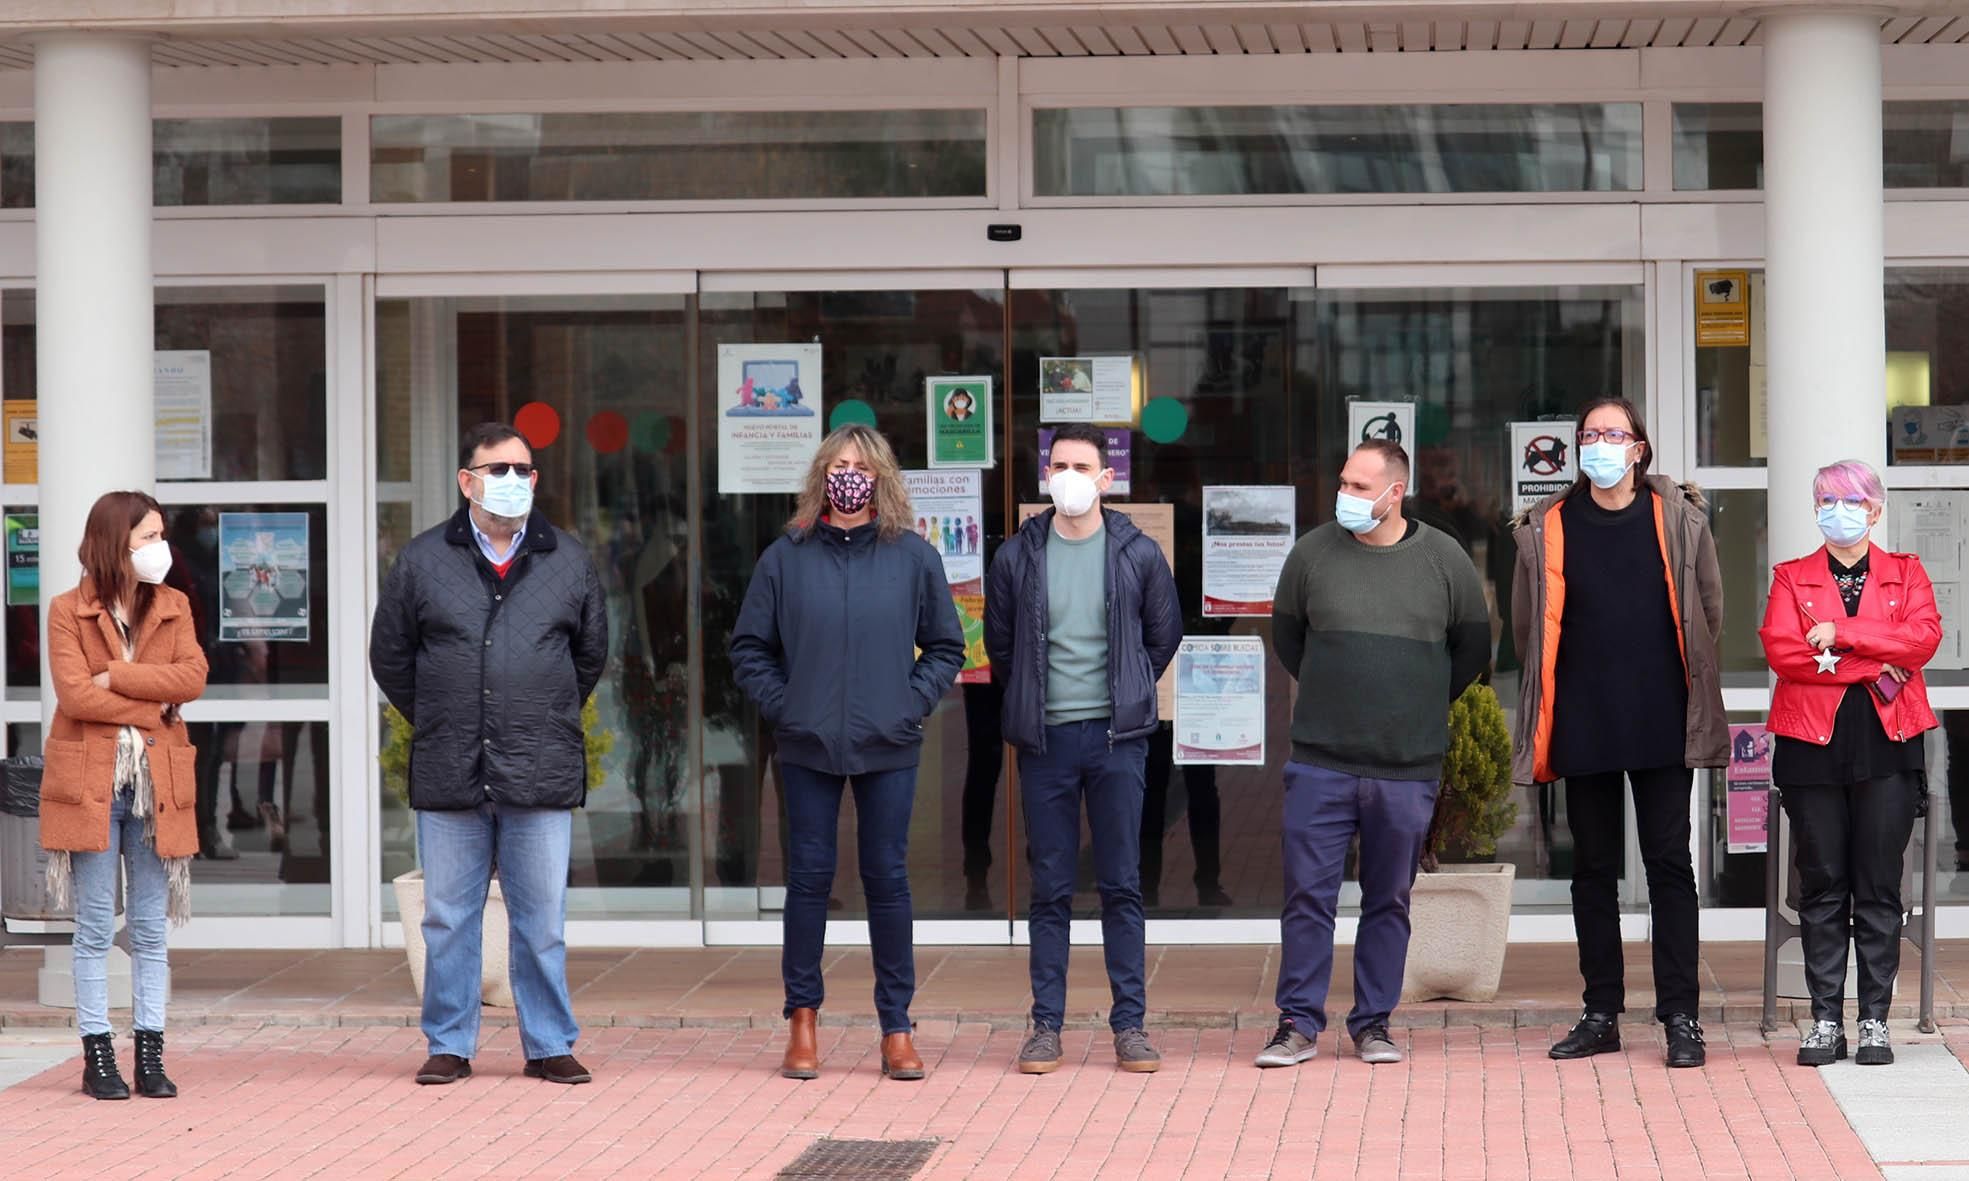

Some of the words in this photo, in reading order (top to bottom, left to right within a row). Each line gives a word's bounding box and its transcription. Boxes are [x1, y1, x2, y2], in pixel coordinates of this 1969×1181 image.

[731, 431, 768, 440] INFANCIA
[769, 431, 775, 440] Y
[776, 431, 813, 440] FAMILIAS
[1108, 437, 1119, 446] DE
[948, 475, 969, 485] con
[1521, 483, 1570, 493] PROHIBIDO
